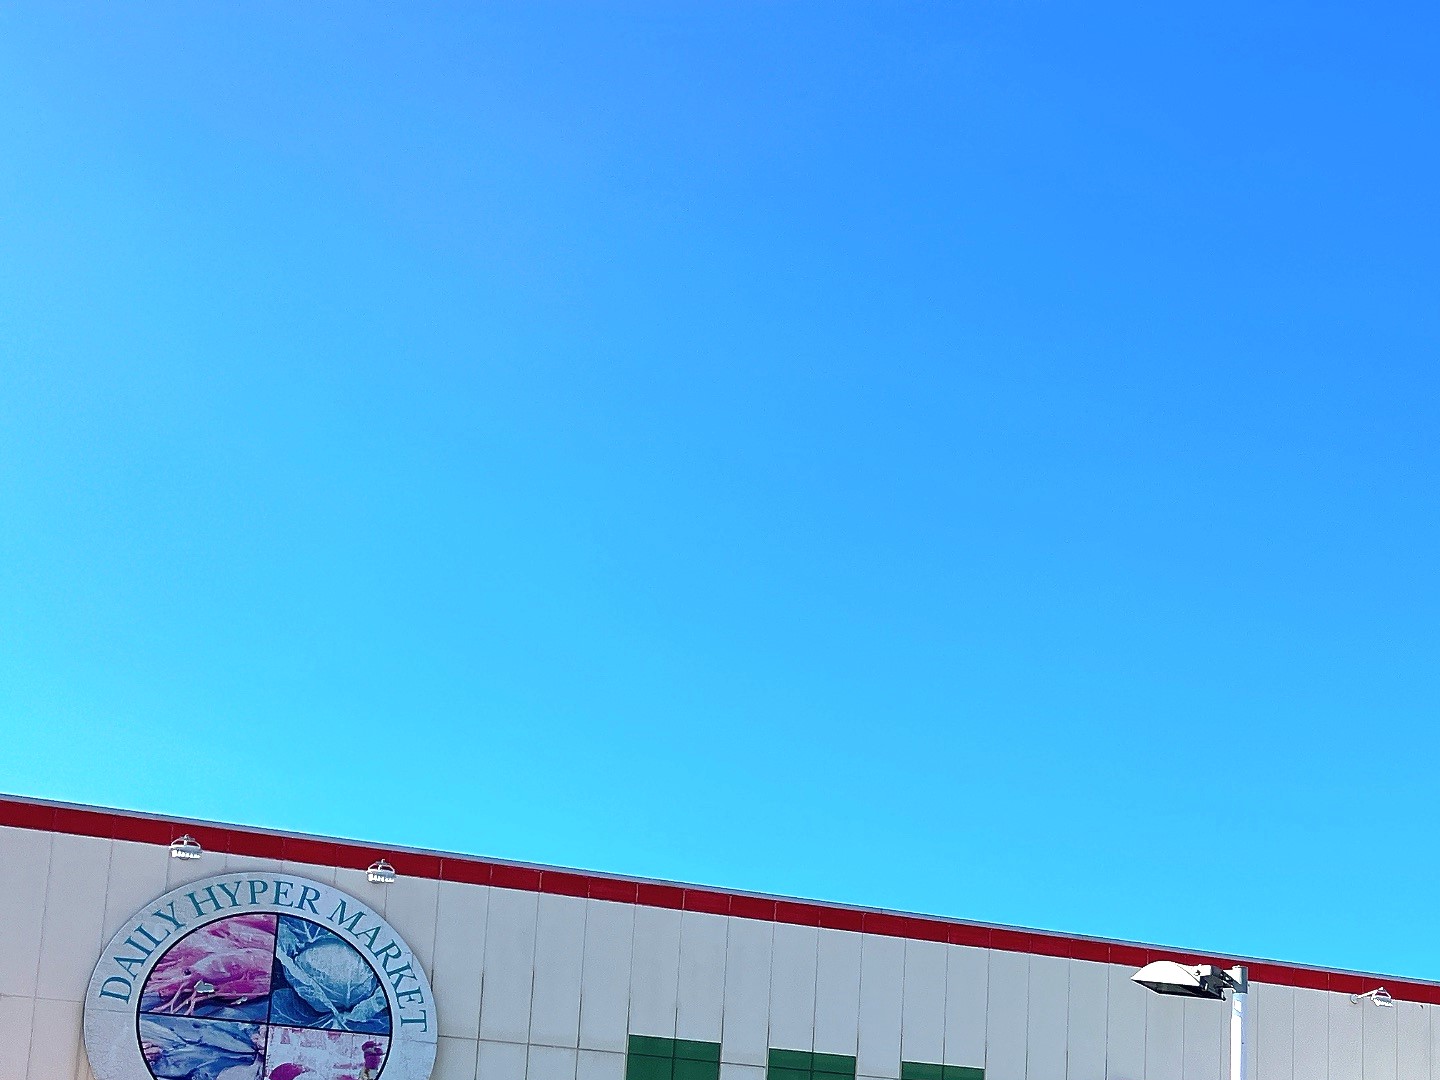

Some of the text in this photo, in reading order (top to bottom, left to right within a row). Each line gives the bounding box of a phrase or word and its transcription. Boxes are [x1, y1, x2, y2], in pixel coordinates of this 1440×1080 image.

[99, 879, 428, 1034] DAILY HYPER MARKET
